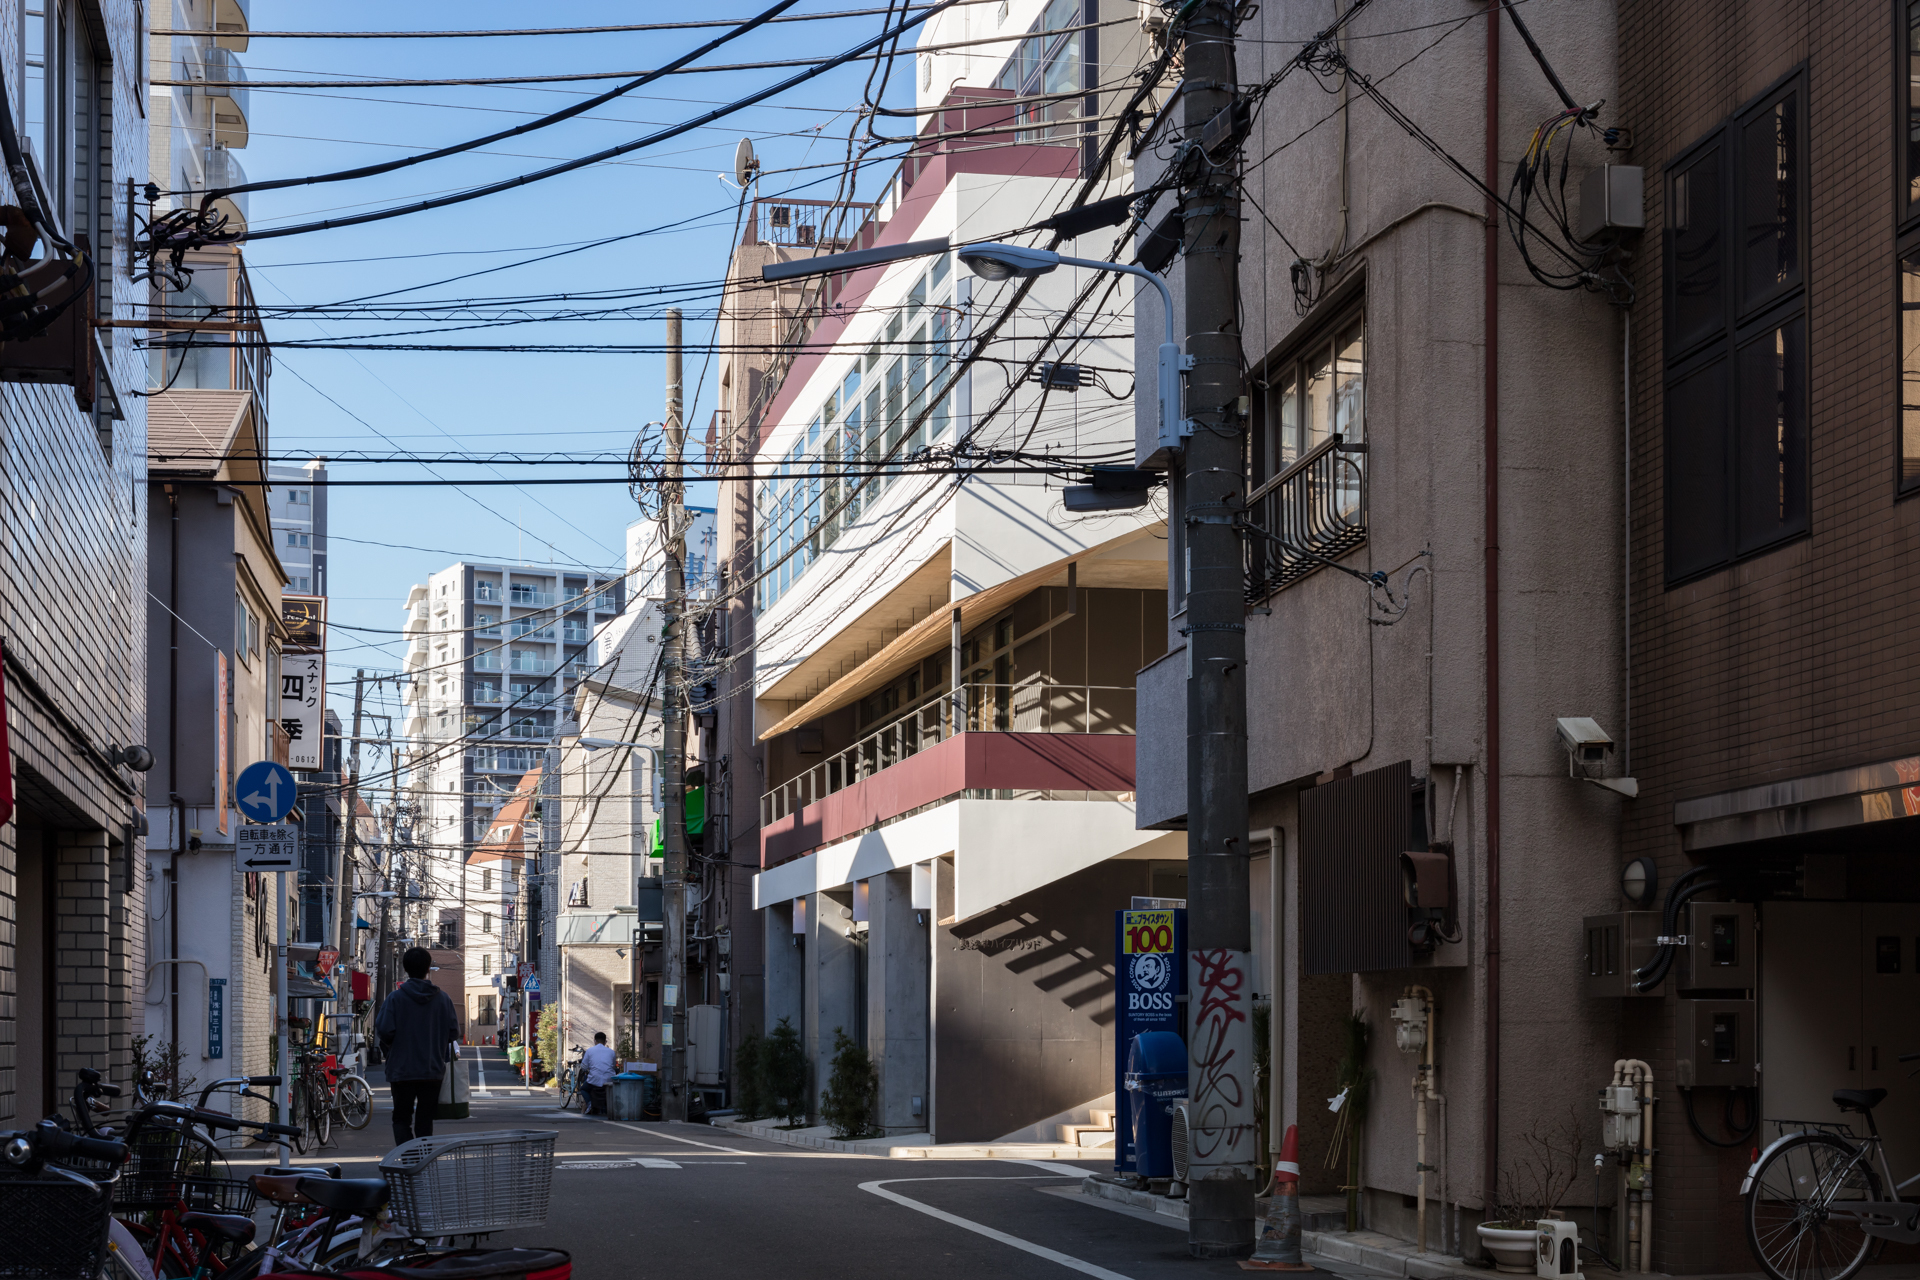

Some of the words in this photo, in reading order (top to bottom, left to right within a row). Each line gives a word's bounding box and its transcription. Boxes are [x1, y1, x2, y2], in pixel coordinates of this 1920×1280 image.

[305, 659, 318, 708] スナック
[281, 675, 304, 745] 四季
[239, 829, 295, 841] 自転車を除く
[239, 842, 295, 855] 一方通行
[1128, 992, 1172, 1010] BOSS
[211, 1045, 221, 1055] 17
